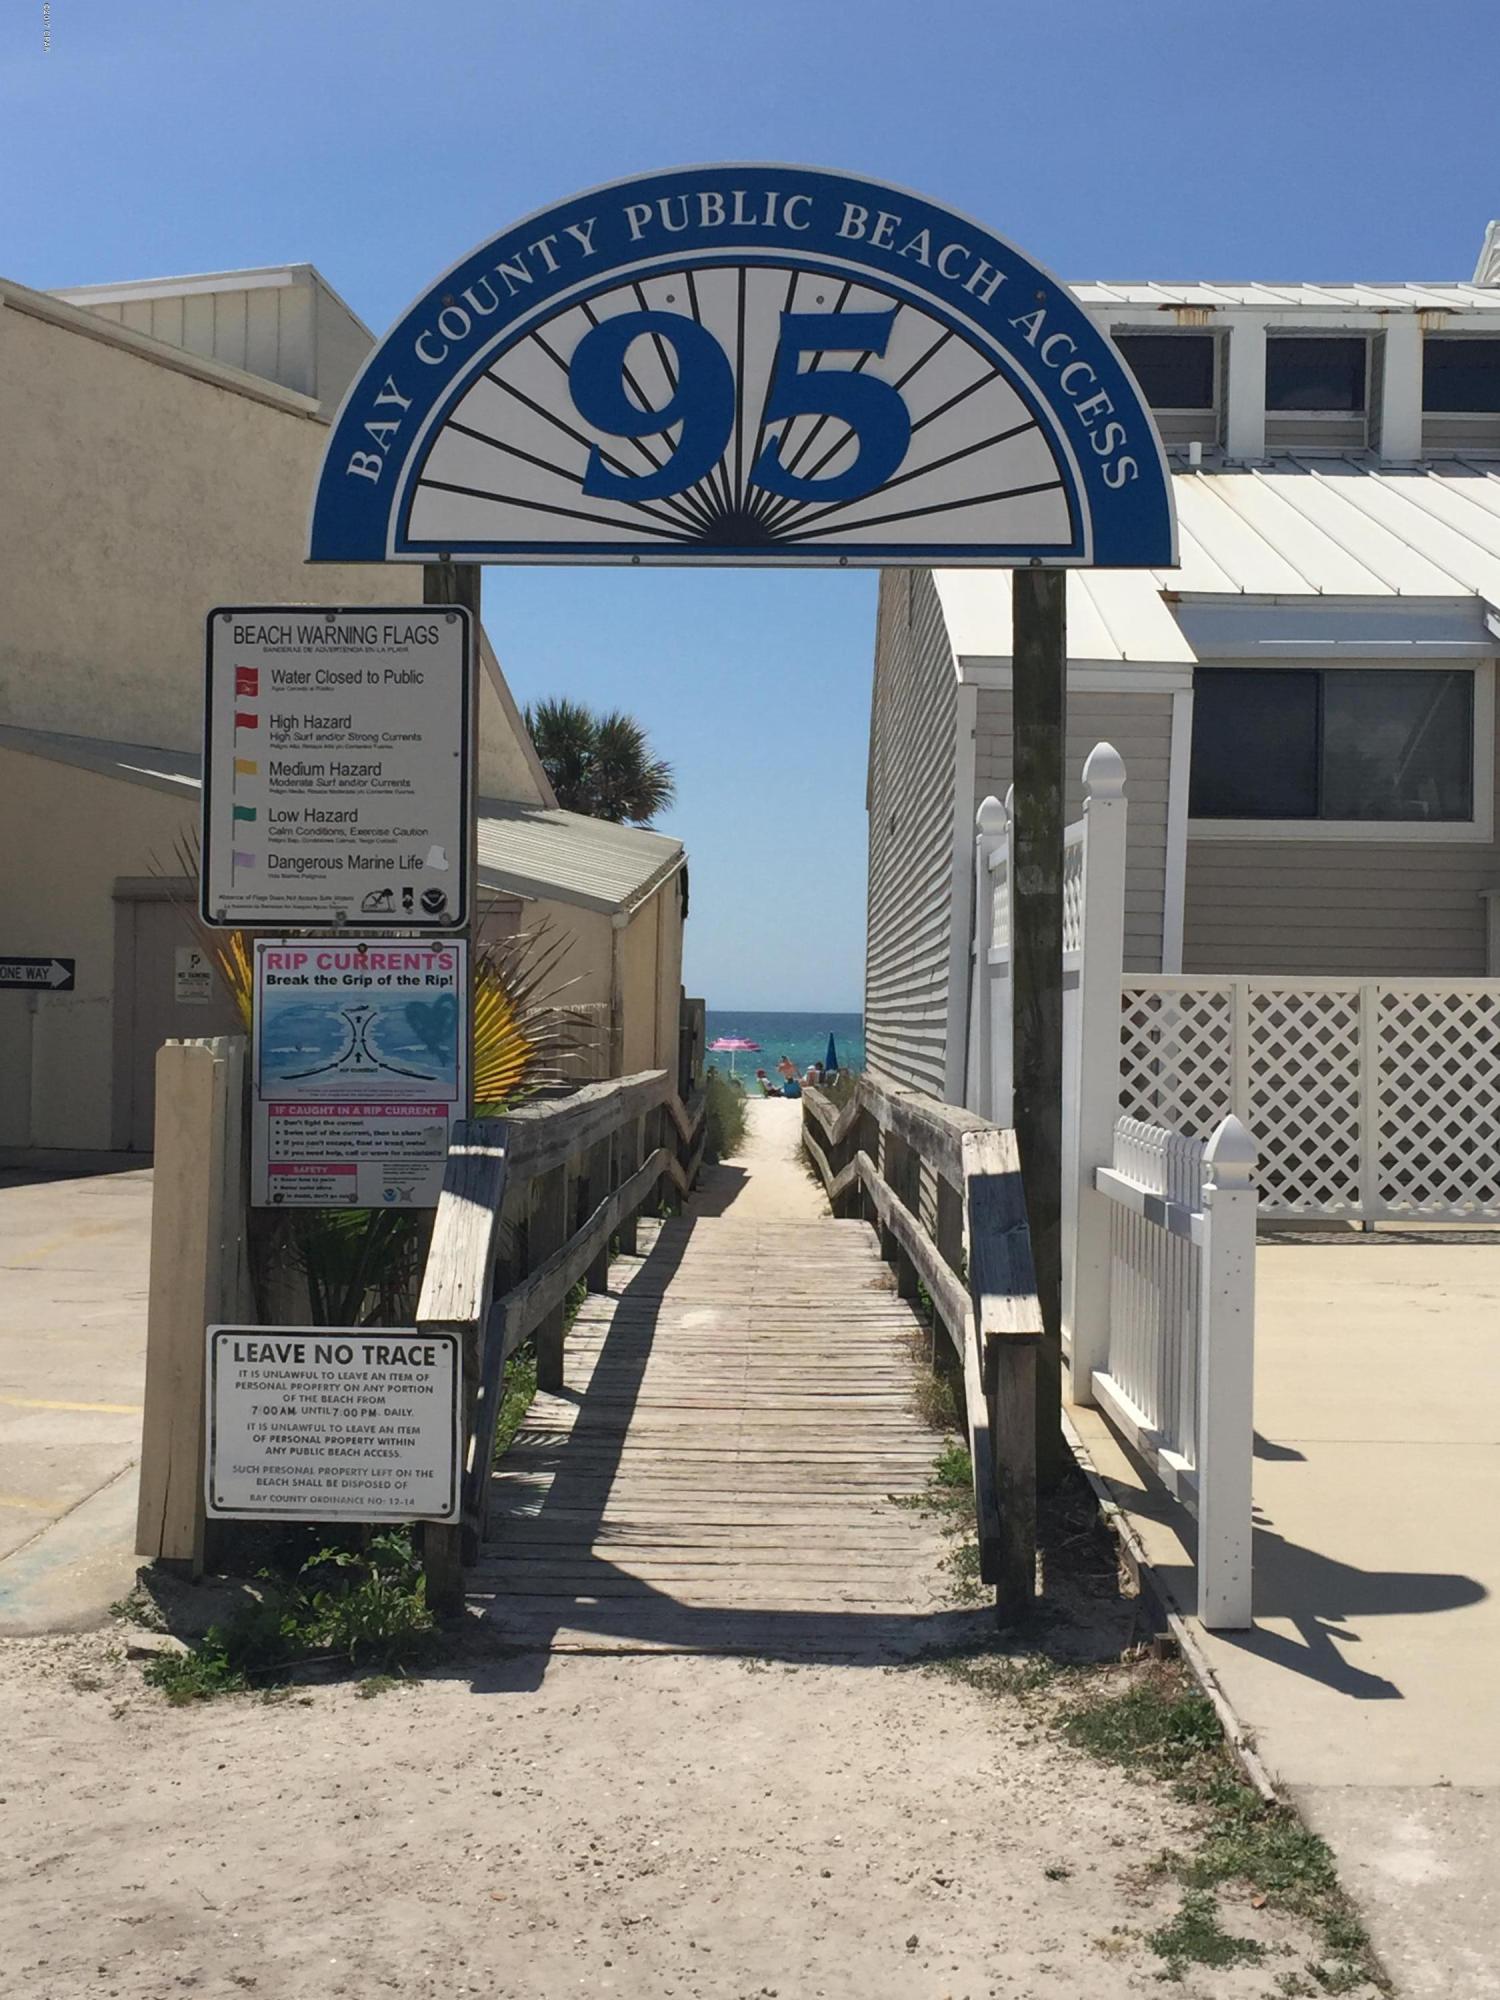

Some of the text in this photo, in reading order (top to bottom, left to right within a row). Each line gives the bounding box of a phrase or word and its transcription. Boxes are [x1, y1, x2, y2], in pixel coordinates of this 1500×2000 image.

[346, 191, 1139, 489] BAY COUNTY PUBLIC BEACH ACCESS
[568, 310, 912, 503] 95
[234, 626, 439, 644] BEACH WARNING FLAGS
[272, 670, 424, 684] Water Closed to Public
[270, 715, 351, 731] High Hazard
[270, 733, 422, 742] High Surf and/or Strong Currents
[269, 761, 381, 776] Medium Hazard
[269, 778, 411, 787] Moderate Surf and/or Currents
[269, 808, 358, 823] Low Hazard
[269, 827, 293, 836] Calm
[350, 827, 389, 836] Exercise
[393, 827, 428, 836] Caution
[268, 854, 423, 872] Dangerous Marine Life
[267, 953, 453, 970] RIP CURRENTS
[0, 967, 49, 980] ONE WAY
[267, 975, 453, 987] Break the Grip of the Rip!
[275, 1106, 438, 1115] IF CAUGHT IN A RIP CURRENT
[234, 1343, 436, 1366] LEAVE NO TRACE
[239, 1369, 430, 1381] IT IS UNLAWFUL TO LEAVE AN ITEM OF
[235, 1382, 433, 1393] PERSONAL PROPERTY ON ANY PORTION
[283, 1394, 385, 1404] OF THE BEACH FROM
[248, 1423, 421, 1434] IT IS UNLAWFUL TO LEAVE AN ITEM
[253, 1435, 415, 1446] OF PERSONAL PROPERTY WITHIN
[266, 1447, 286, 1455] ANY
[290, 1447, 324, 1456] PUBLIC
[328, 1448, 360, 1456] BEACH
[233, 1465, 434, 1478] SUCH PERSONAL PROPERTY LEFT ON THE
[256, 1478, 408, 1489] BEACH SHALL BE DISPOSED OF
[250, 1494, 267, 1502] BAY
[270, 1495, 307, 1503] COUNTY
[310, 1496, 364, 1504] ORDINANCE
[389, 1497, 415, 1505] 12-14
